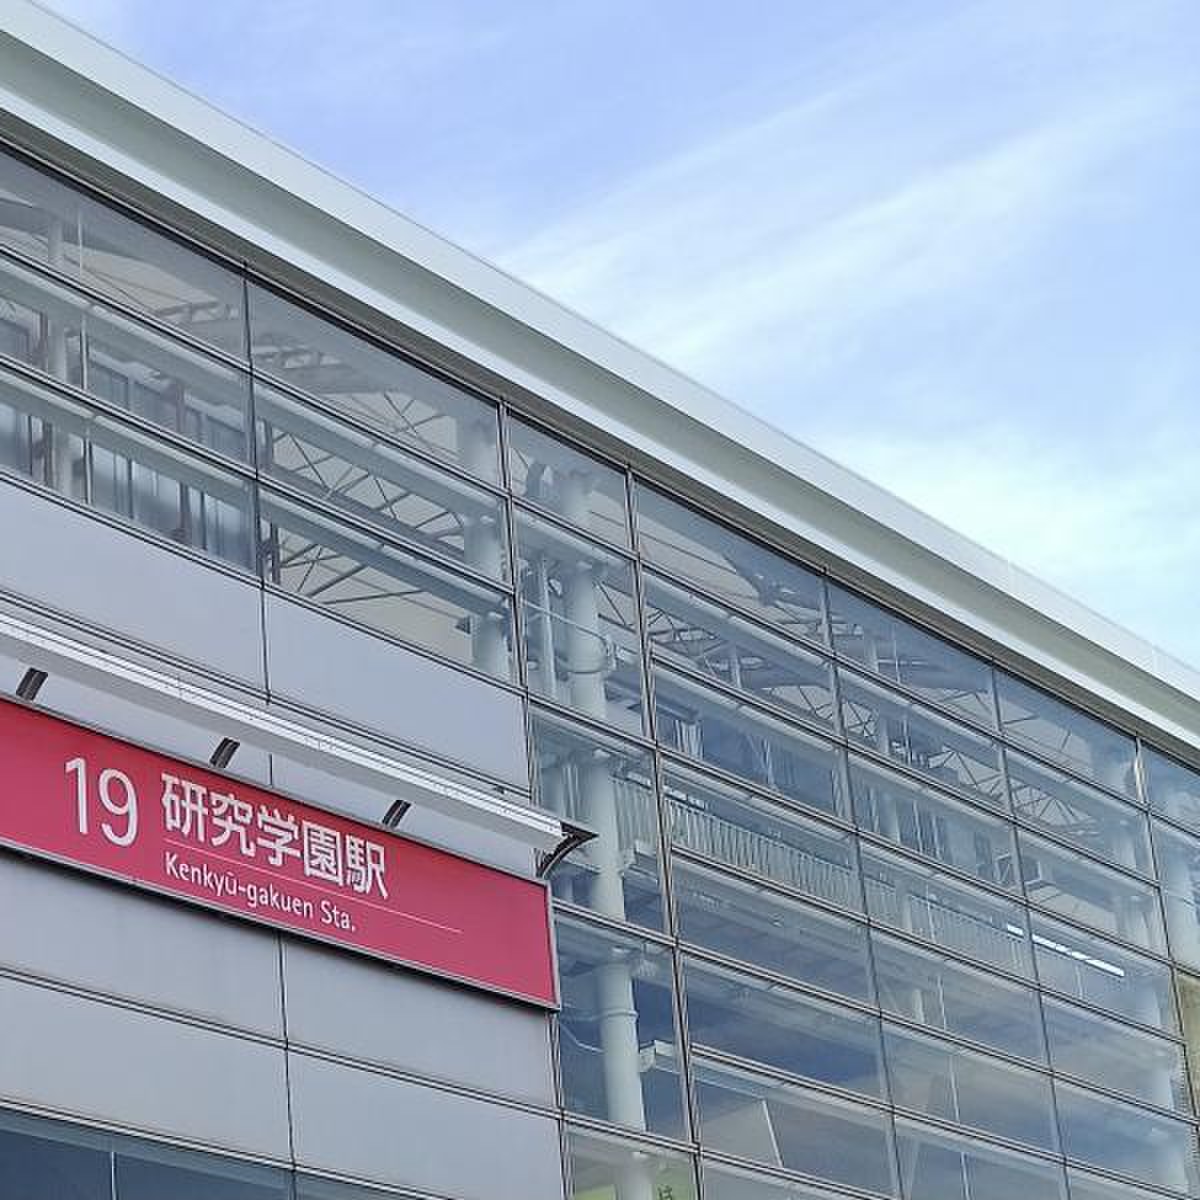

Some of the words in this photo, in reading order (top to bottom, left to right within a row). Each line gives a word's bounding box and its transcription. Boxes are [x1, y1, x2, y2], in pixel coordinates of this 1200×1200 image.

[65, 757, 140, 847] 19
[160, 772, 389, 899] 研究学園駅
[164, 851, 315, 918] Kenkyū-gakuen
[320, 900, 356, 931] Sta.
